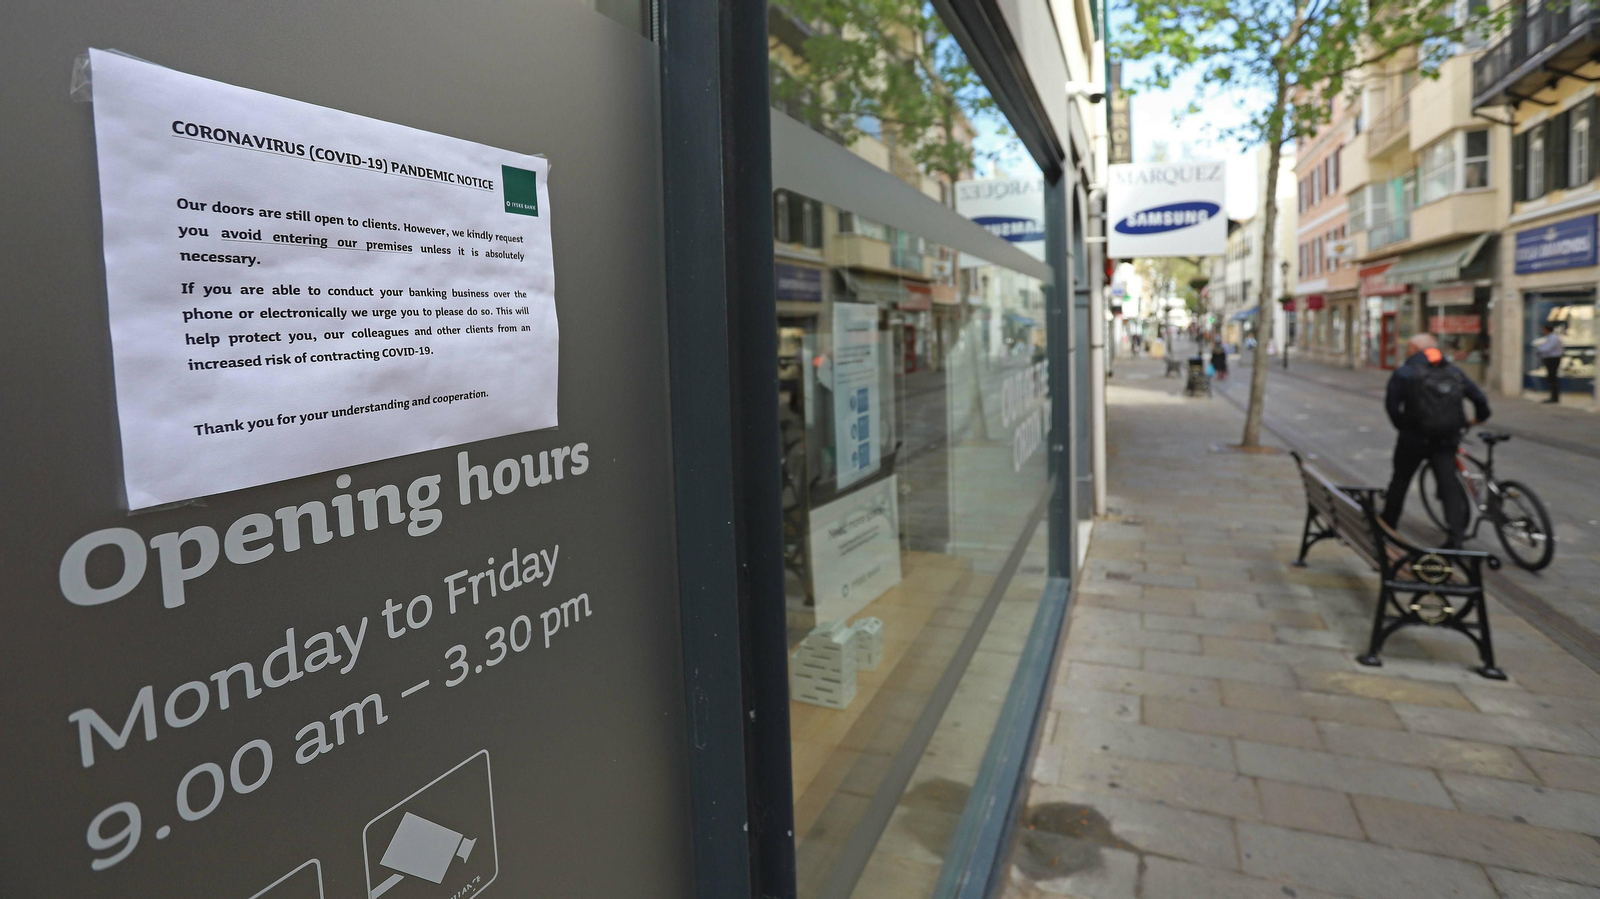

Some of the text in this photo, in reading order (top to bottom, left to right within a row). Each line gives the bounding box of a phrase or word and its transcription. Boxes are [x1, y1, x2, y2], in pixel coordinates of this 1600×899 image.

[172, 120, 494, 190] CORONAVIRUS (COVID-19) PANDEMIC NOTICE
[1116, 165, 1222, 187] MARQUEZ
[177, 198, 207, 211] Our
[212, 201, 254, 216] doors
[259, 209, 282, 219] are
[286, 210, 311, 222] still
[314, 215, 344, 226] open
[347, 217, 359, 227] to
[362, 218, 400, 231] clients.
[403, 223, 449, 237] However,
[467, 229, 493, 242] kindly
[495, 234, 523, 244] request
[1126, 208, 1210, 229] SAMSUNG
[178, 226, 524, 262] you avoid entering our premises unless it is absolutely
[179, 252, 261, 267] necessary.
[181, 282, 195, 294] If
[203, 286, 232, 298] you
[240, 287, 264, 295] are
[272, 284, 300, 295] able
[308, 286, 321, 296] to
[328, 286, 374, 296] conduct
[380, 289, 403, 299] your
[409, 287, 447, 300] banking
[452, 288, 489, 297] business
[514, 290, 526, 298] the
[182, 307, 233, 323] phone
[239, 310, 254, 319] or
[260, 307, 347, 320] electronically
[372, 309, 397, 320] urge
[400, 309, 419, 319] you
[422, 308, 432, 316] to
[435, 307, 463, 319] please
[467, 307, 478, 315] do
[496, 307, 513, 315] This
[515, 307, 529, 315] will
[185, 332, 220, 348] help
[228, 332, 282, 347] protect
[288, 333, 317, 344] you,
[324, 331, 345, 340] our
[351, 328, 409, 340] colleagues
[414, 326, 432, 336] and
[437, 326, 461, 335] other
[465, 325, 493, 334] clients
[498, 324, 517, 332] from
[188, 346, 434, 371] increased risk of contracting COVID-19.
[193, 390, 489, 436] Thank you for your understanding and cooperation.
[59, 442, 589, 609] Opening hours
[68, 544, 559, 768] Monday to Friday
[87, 739, 273, 870] 9.00
[295, 693, 388, 764] am
[444, 615, 532, 687] 3.30
[540, 593, 592, 649] pm
